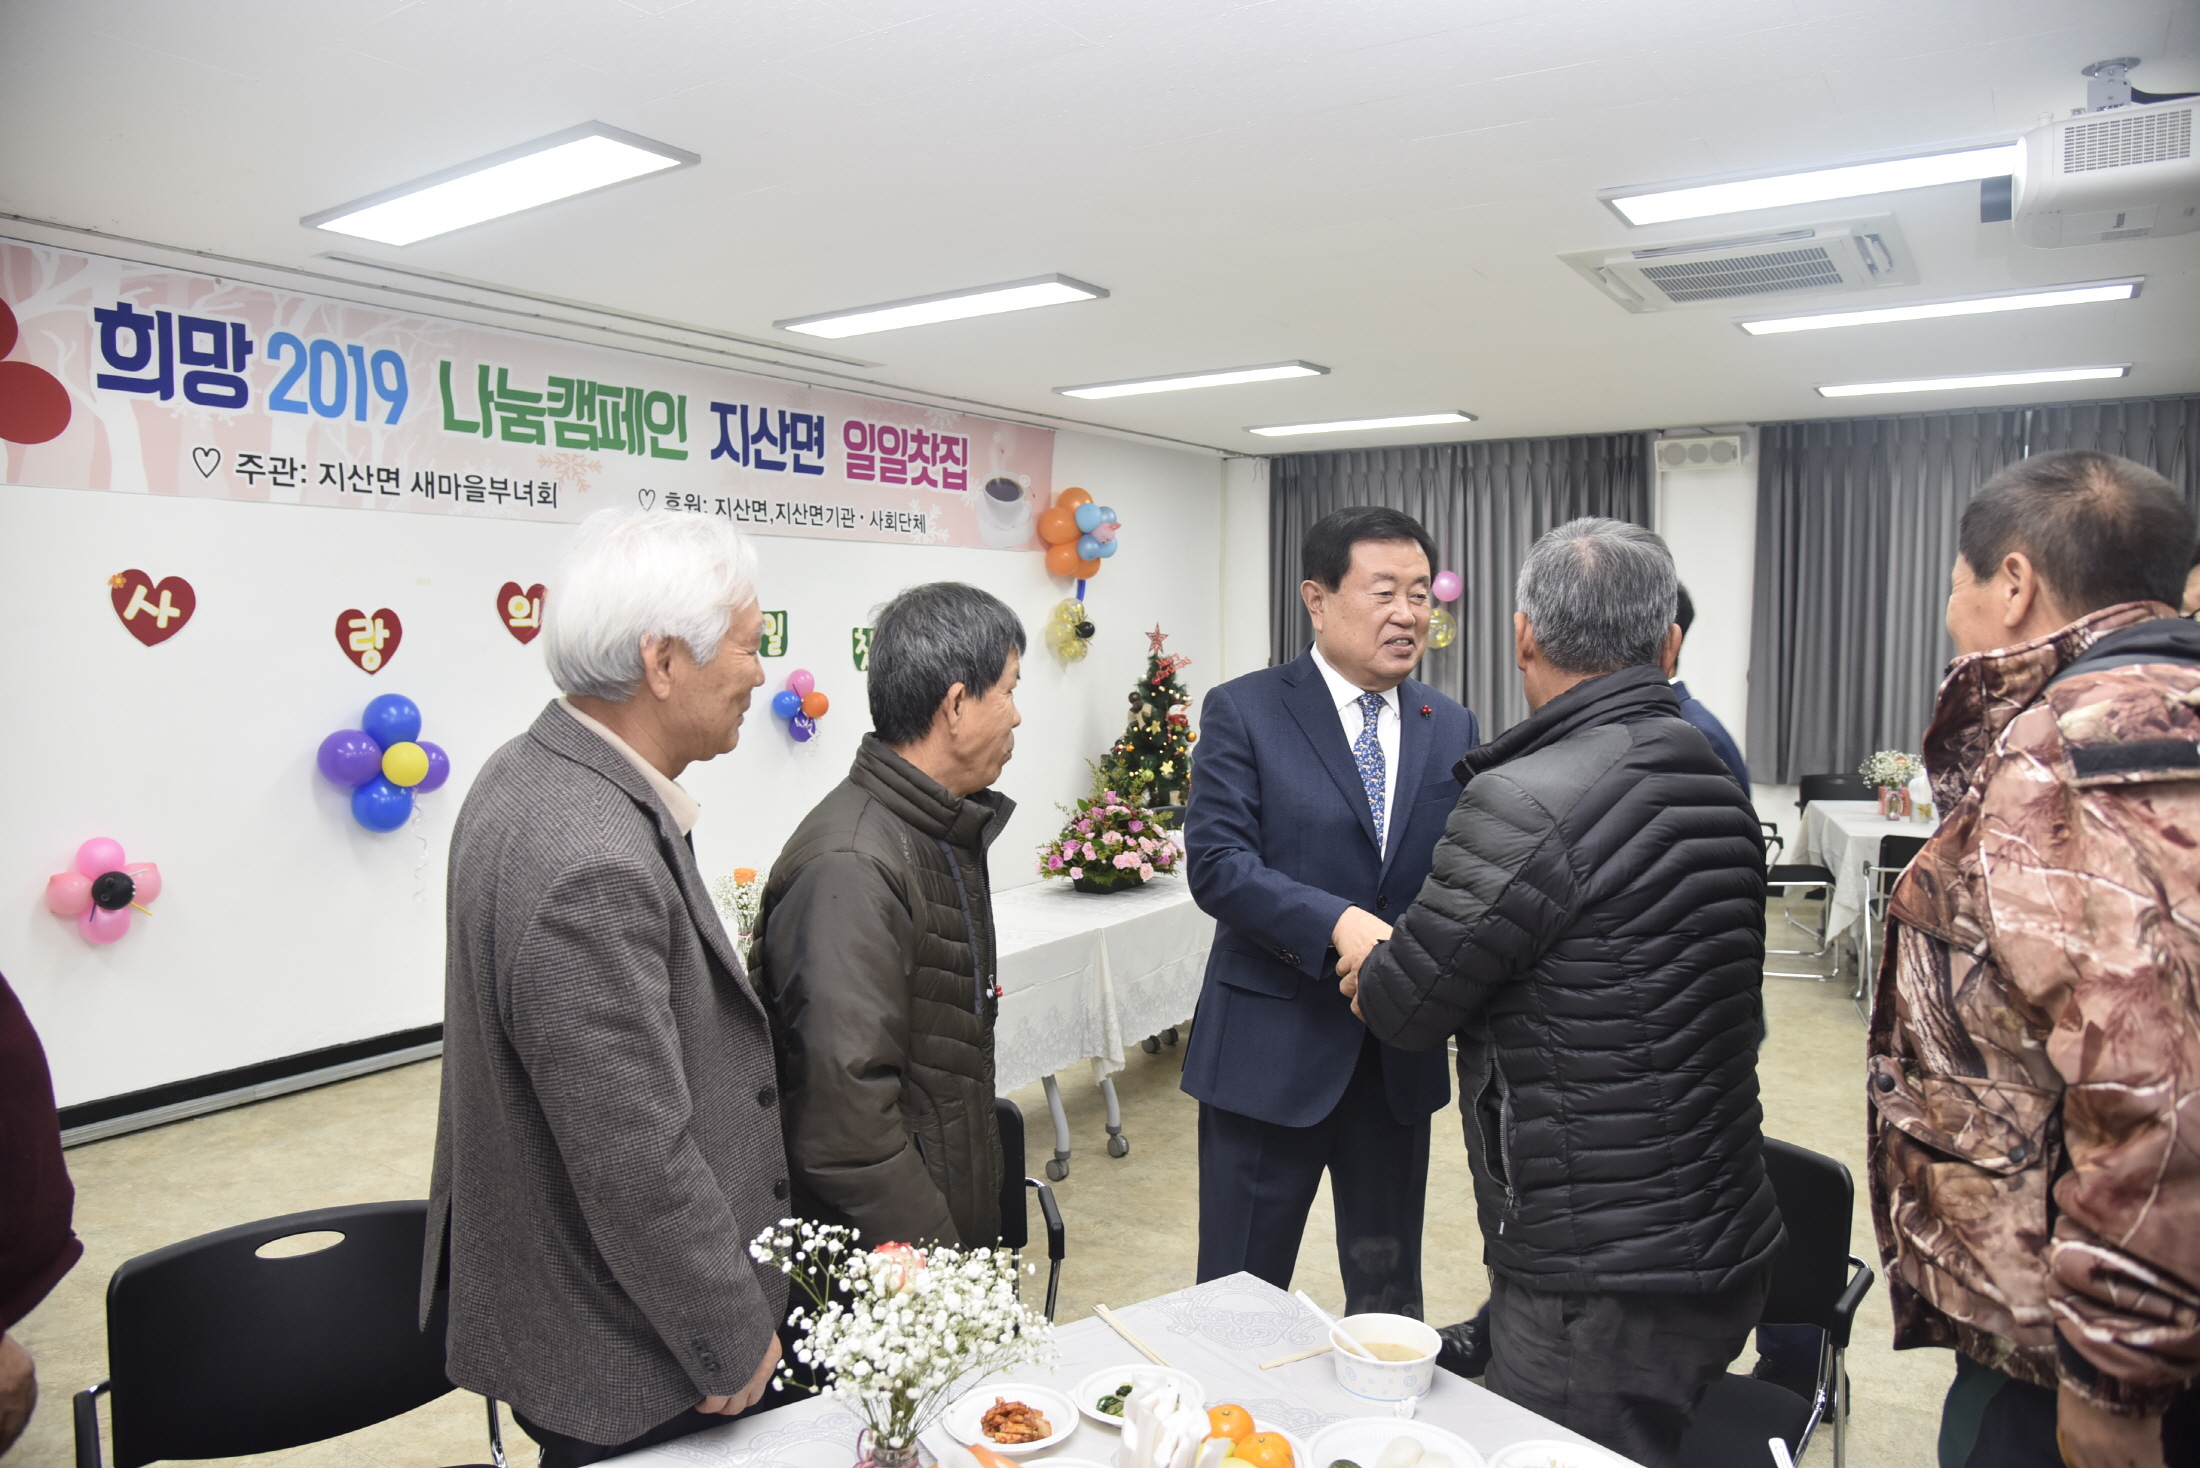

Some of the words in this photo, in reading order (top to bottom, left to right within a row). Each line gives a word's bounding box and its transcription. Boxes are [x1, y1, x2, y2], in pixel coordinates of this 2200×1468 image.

[94, 301, 253, 409] 희망
[267, 331, 409, 425] 2019
[439, 360, 689, 461] 나눔캠페인
[710, 402, 825, 476] 지산면
[843, 420, 968, 491] 일일찻집
[235, 453, 307, 488] 주관:
[319, 462, 401, 496] 지산면
[410, 471, 558, 509] 새마을부녀회
[123, 584, 181, 629] 사
[348, 618, 390, 671] 랑
[508, 595, 540, 628] 의
